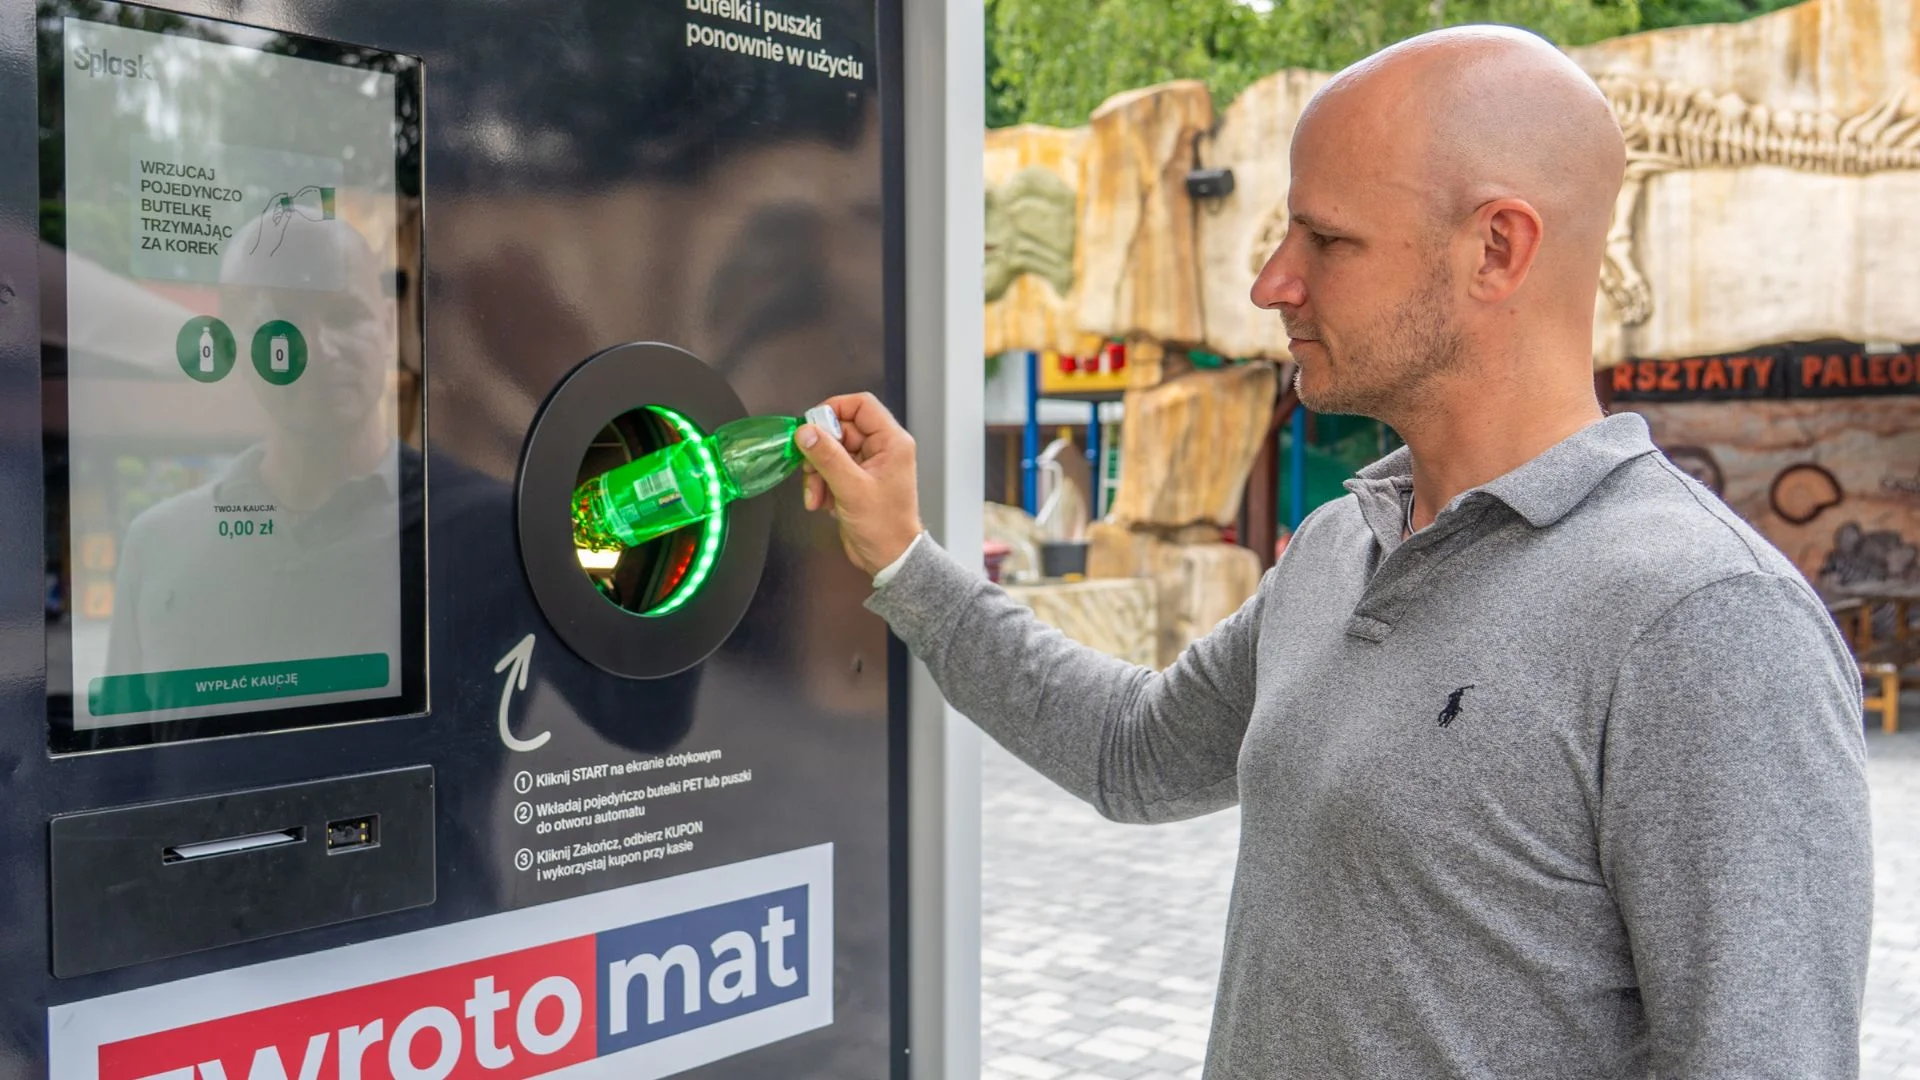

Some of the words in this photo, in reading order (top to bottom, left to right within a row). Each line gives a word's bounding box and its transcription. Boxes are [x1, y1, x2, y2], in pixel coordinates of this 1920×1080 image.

[755, 2, 761, 26] i
[764, 9, 822, 40] puszki
[686, 22, 784, 62] ponownie
[786, 46, 805, 66] w
[807, 49, 864, 80] użyciu
[140, 160, 215, 181] WRZUCAJ
[141, 179, 243, 202] POJEDYNCZO
[141, 198, 212, 221] BUTELKĘ
[141, 217, 233, 241] TRZYMAJĄC
[141, 236, 162, 251] ZA
[165, 239, 219, 256] KOREK
[202, 345, 211, 358] 0
[275, 348, 284, 362] 0
[1802, 352, 1920, 388] PALEO
[213, 505, 242, 513] TWOJA
[219, 520, 254, 539] 0,00
[260, 519, 274, 535] zł
[195, 675, 248, 693] WYPŁAĆ
[251, 672, 299, 687] KAUCJĘ
[536, 770, 571, 788] Kliknij
[572, 764, 609, 782] START
[610, 763, 625, 776] na
[625, 757, 665, 774] ekranie
[665, 749, 722, 767] dotykowym
[536, 798, 582, 817] Wkładaj
[646, 781, 681, 798] butelki
[682, 777, 703, 792] PET
[703, 775, 720, 788] lub
[721, 769, 752, 788] puszki
[536, 821, 553, 835] do
[553, 815, 593, 832] otworu
[593, 805, 646, 824] automatu
[536, 846, 571, 865] Kliknij
[572, 837, 622, 858] Zakończ,
[623, 829, 663, 848] odbierz
[664, 820, 704, 840] KUPON
[536, 869, 541, 882] i
[542, 860, 607, 881] wykorzystaj
[608, 853, 642, 867] kupon
[643, 848, 664, 863] przy
[666, 840, 694, 855] kasie
